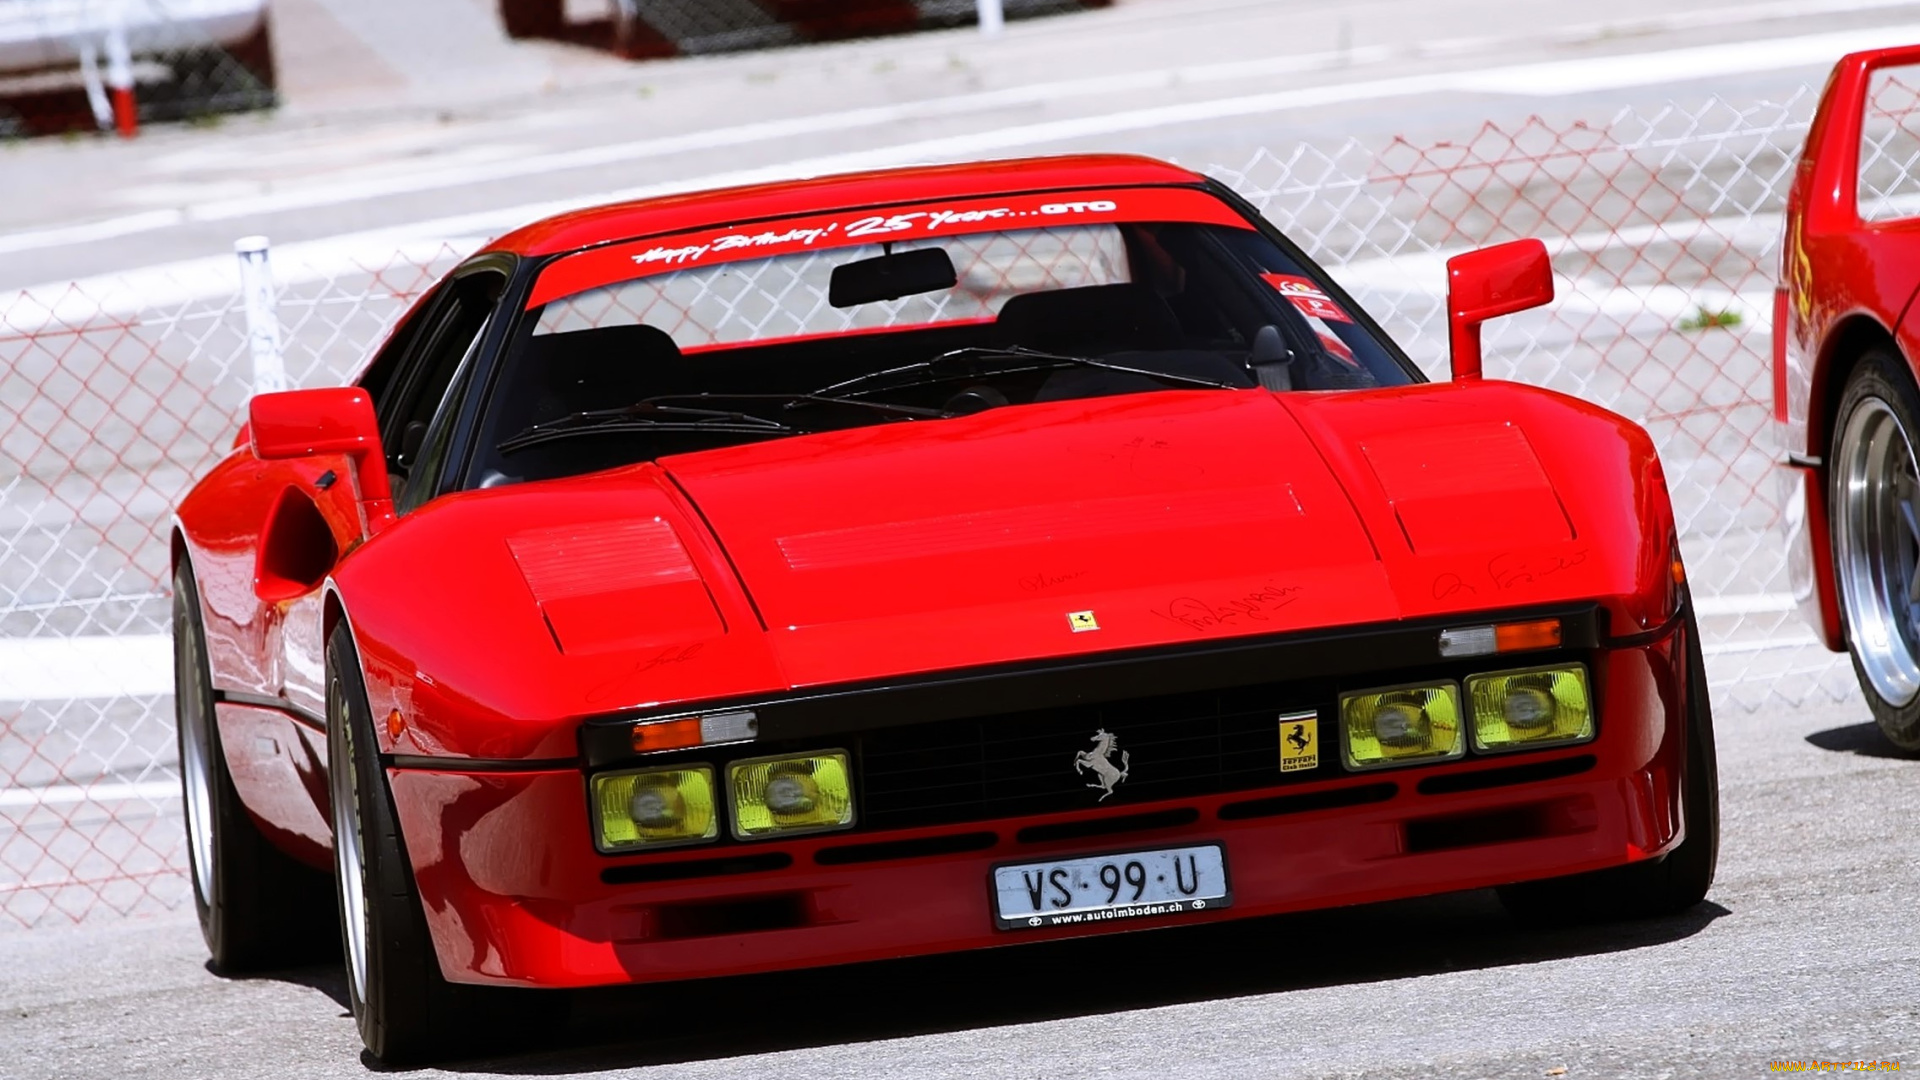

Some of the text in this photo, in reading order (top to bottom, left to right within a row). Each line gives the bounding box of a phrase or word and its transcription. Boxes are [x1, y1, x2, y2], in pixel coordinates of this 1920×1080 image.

[631, 244, 710, 264] Happy
[711, 222, 838, 251] Birthday!
[844, 211, 928, 238] 25
[1051, 901, 1183, 925] www.autoimboden.ch
